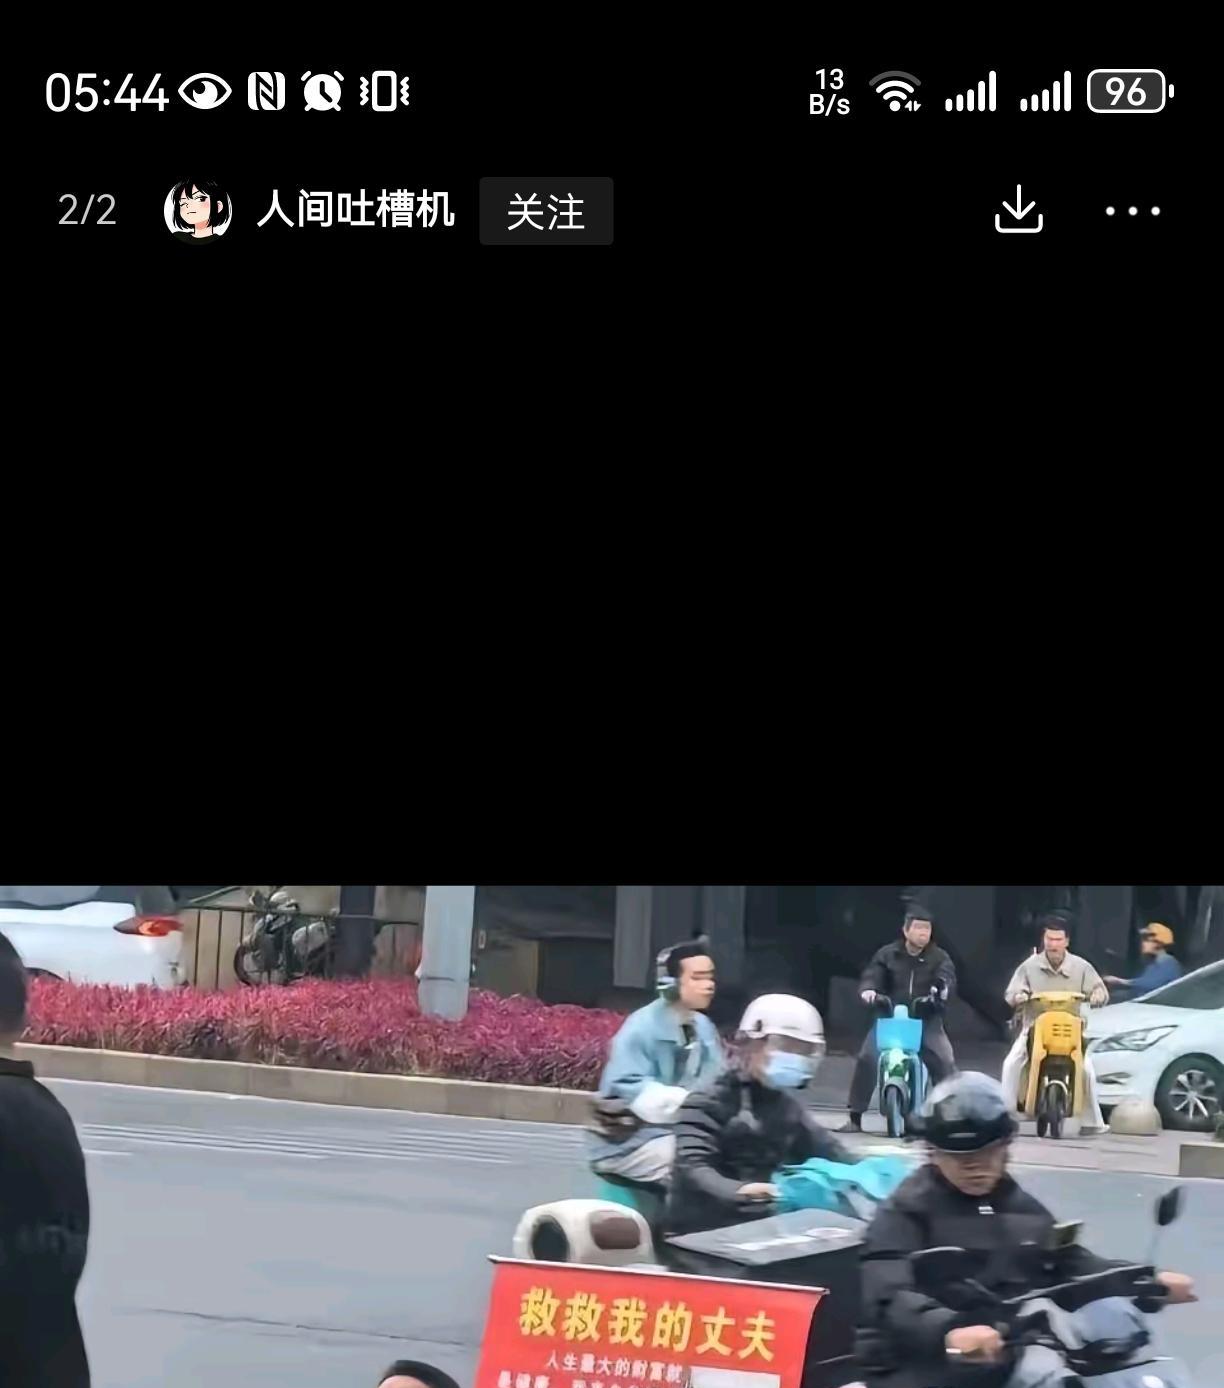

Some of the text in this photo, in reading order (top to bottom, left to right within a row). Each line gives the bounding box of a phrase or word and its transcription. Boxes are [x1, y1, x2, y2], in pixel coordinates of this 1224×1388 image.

[518, 1287, 777, 1362] 救救我的丈夫
